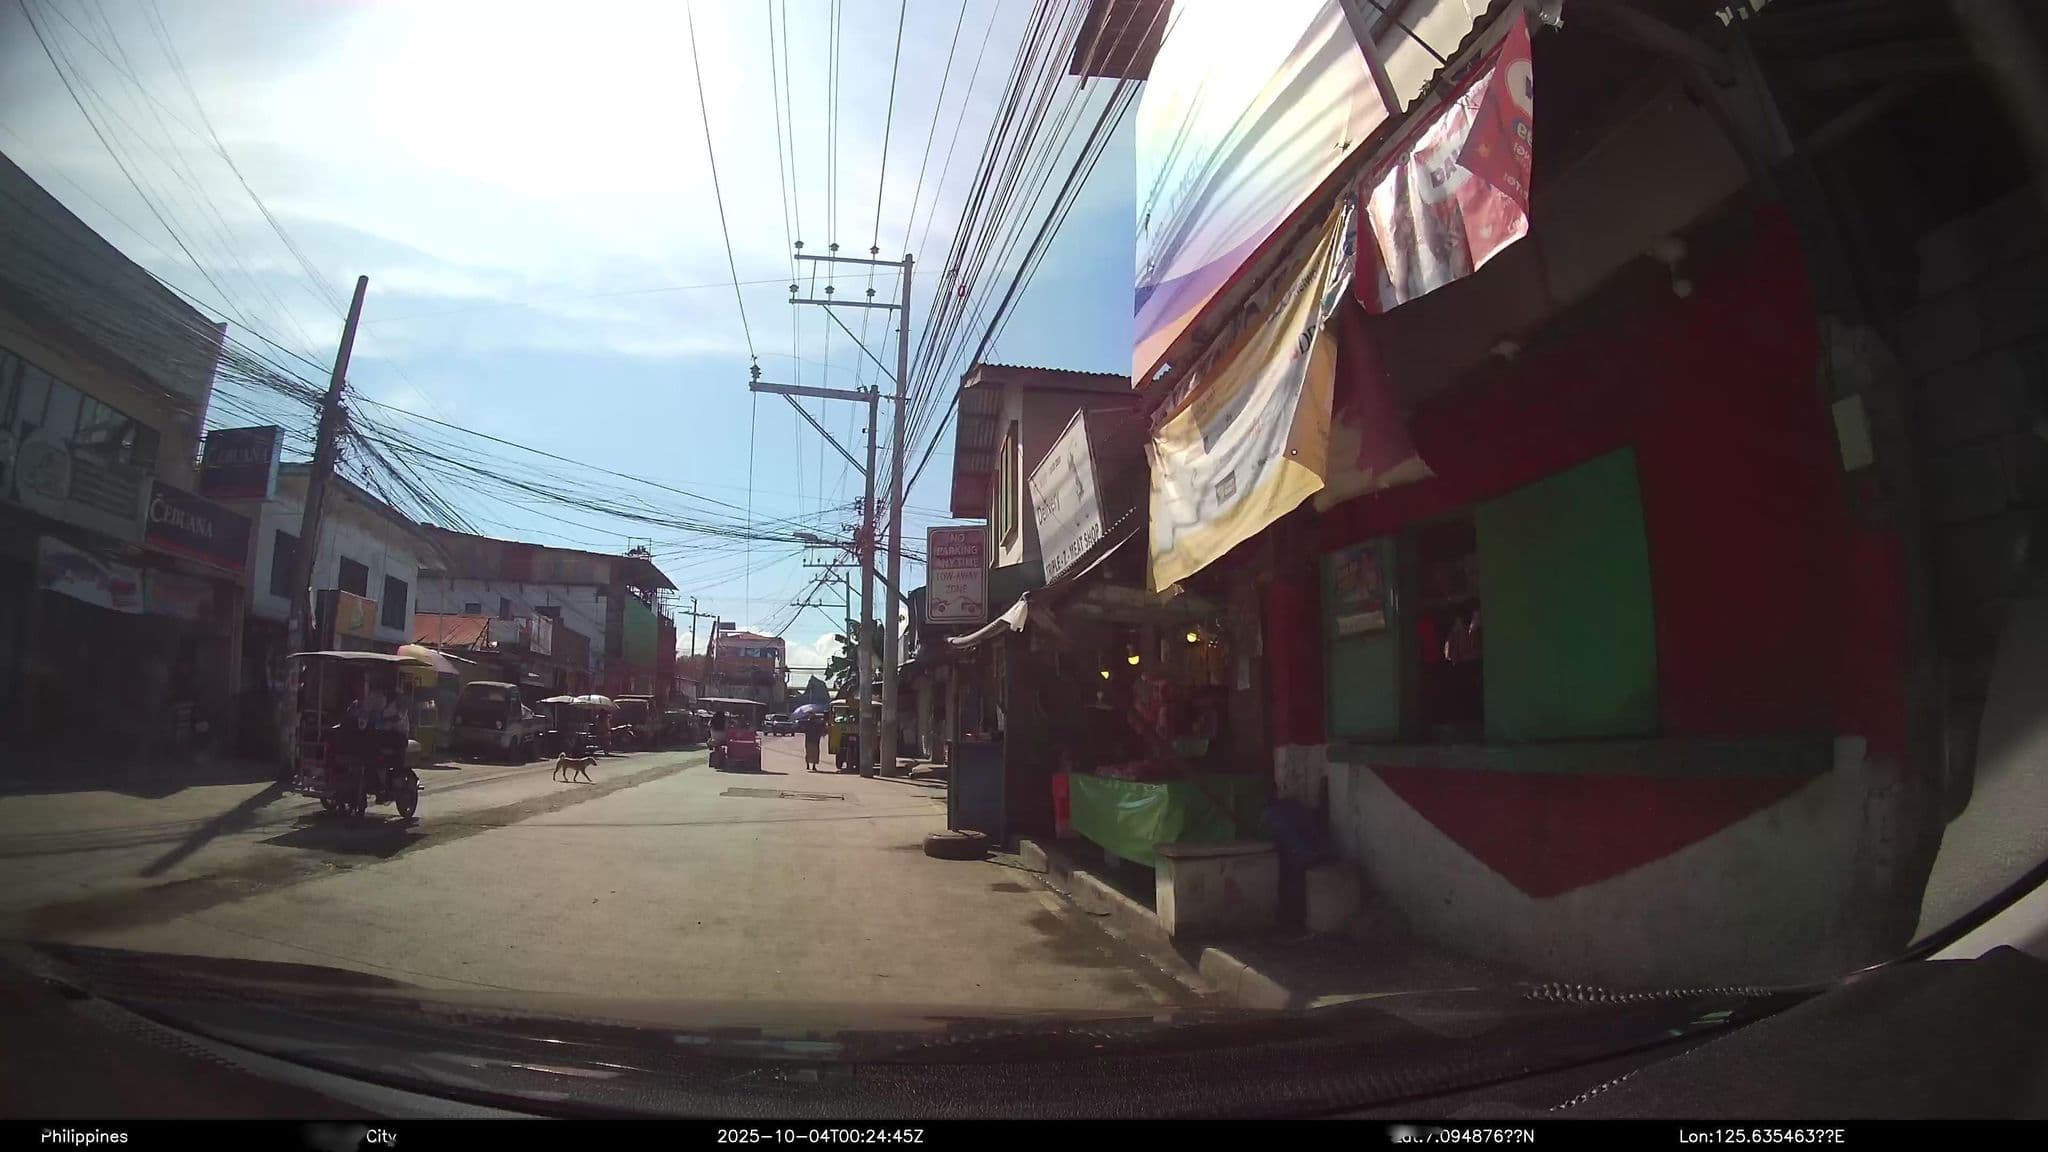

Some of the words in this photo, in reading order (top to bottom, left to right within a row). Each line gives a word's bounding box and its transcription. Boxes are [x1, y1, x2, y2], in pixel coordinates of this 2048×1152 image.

[949, 534, 965, 543] NO
[1083, 523, 1099, 549] SHOP
[936, 544, 978, 556] PARKING
[945, 584, 968, 593] ZONE
